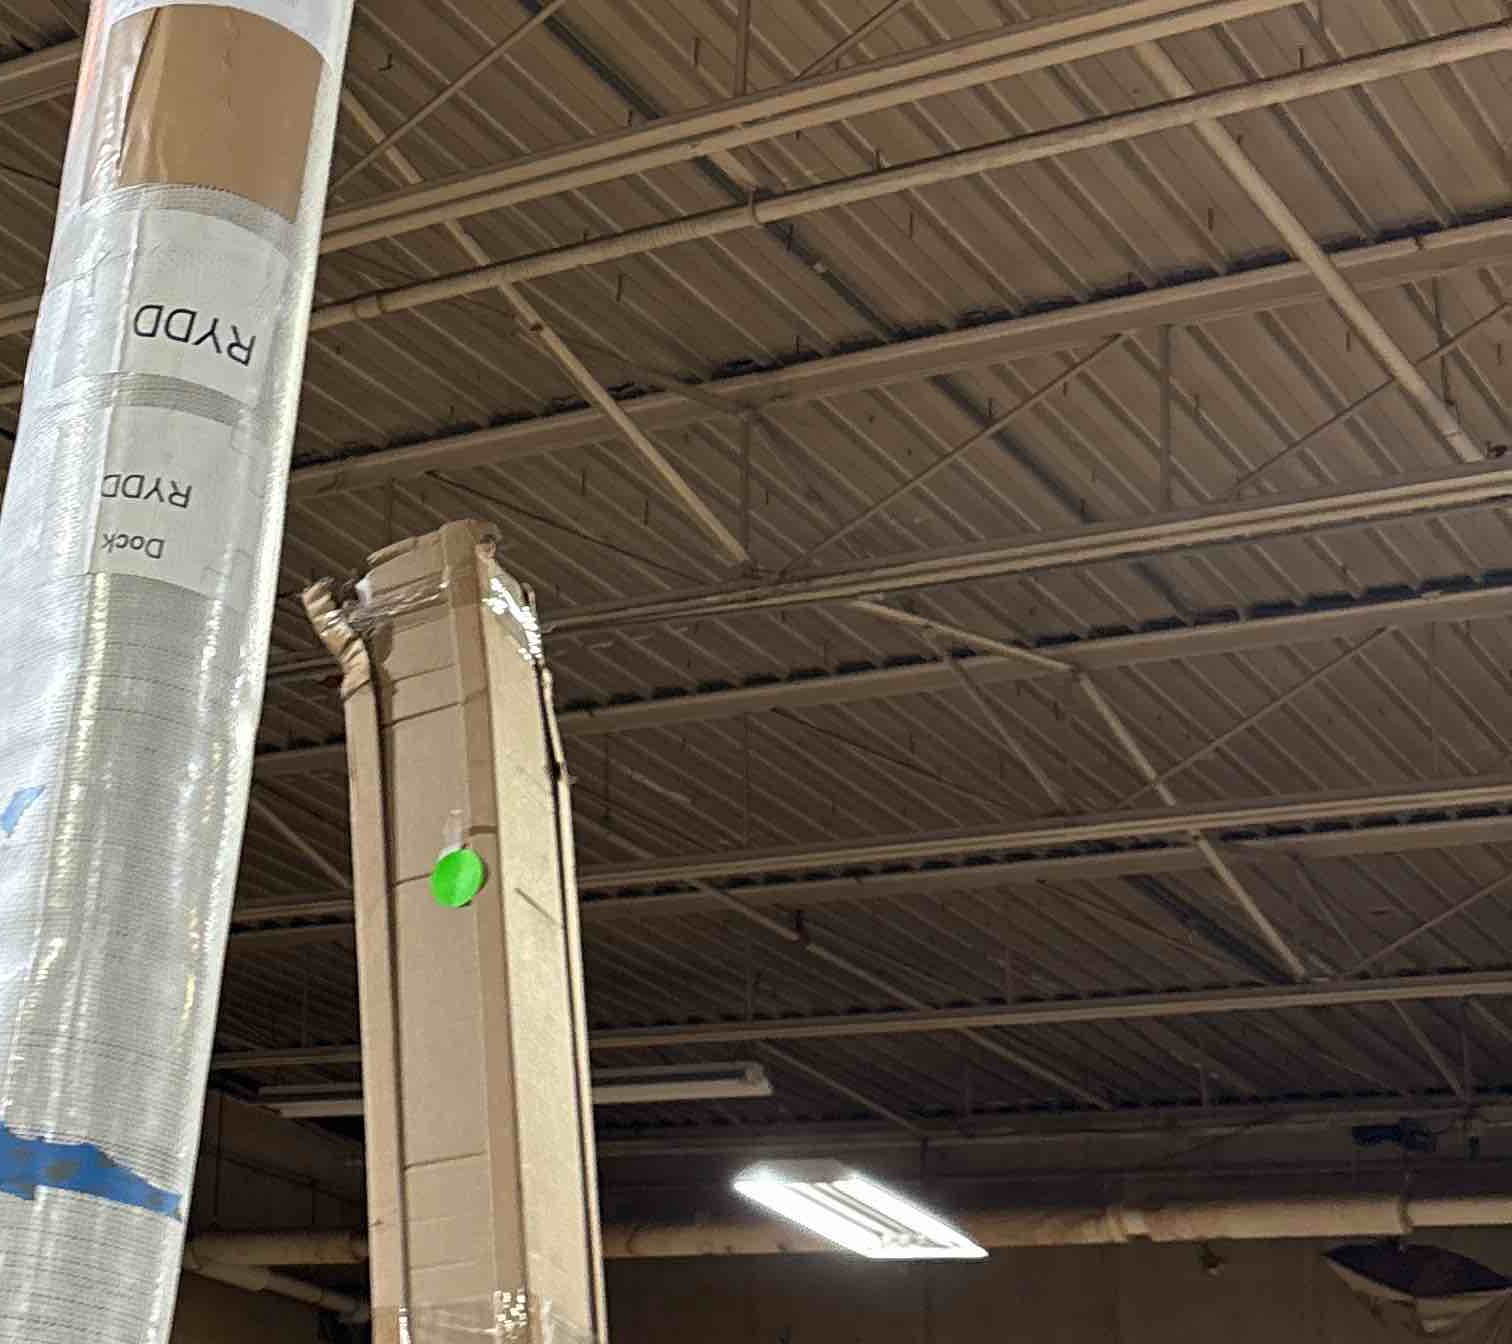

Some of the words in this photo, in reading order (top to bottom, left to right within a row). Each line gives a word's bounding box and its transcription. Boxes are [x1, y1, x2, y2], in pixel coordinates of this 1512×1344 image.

[133, 304, 256, 367] RYDD
[100, 473, 192, 509] RYDD
[101, 531, 165, 559] Dock
